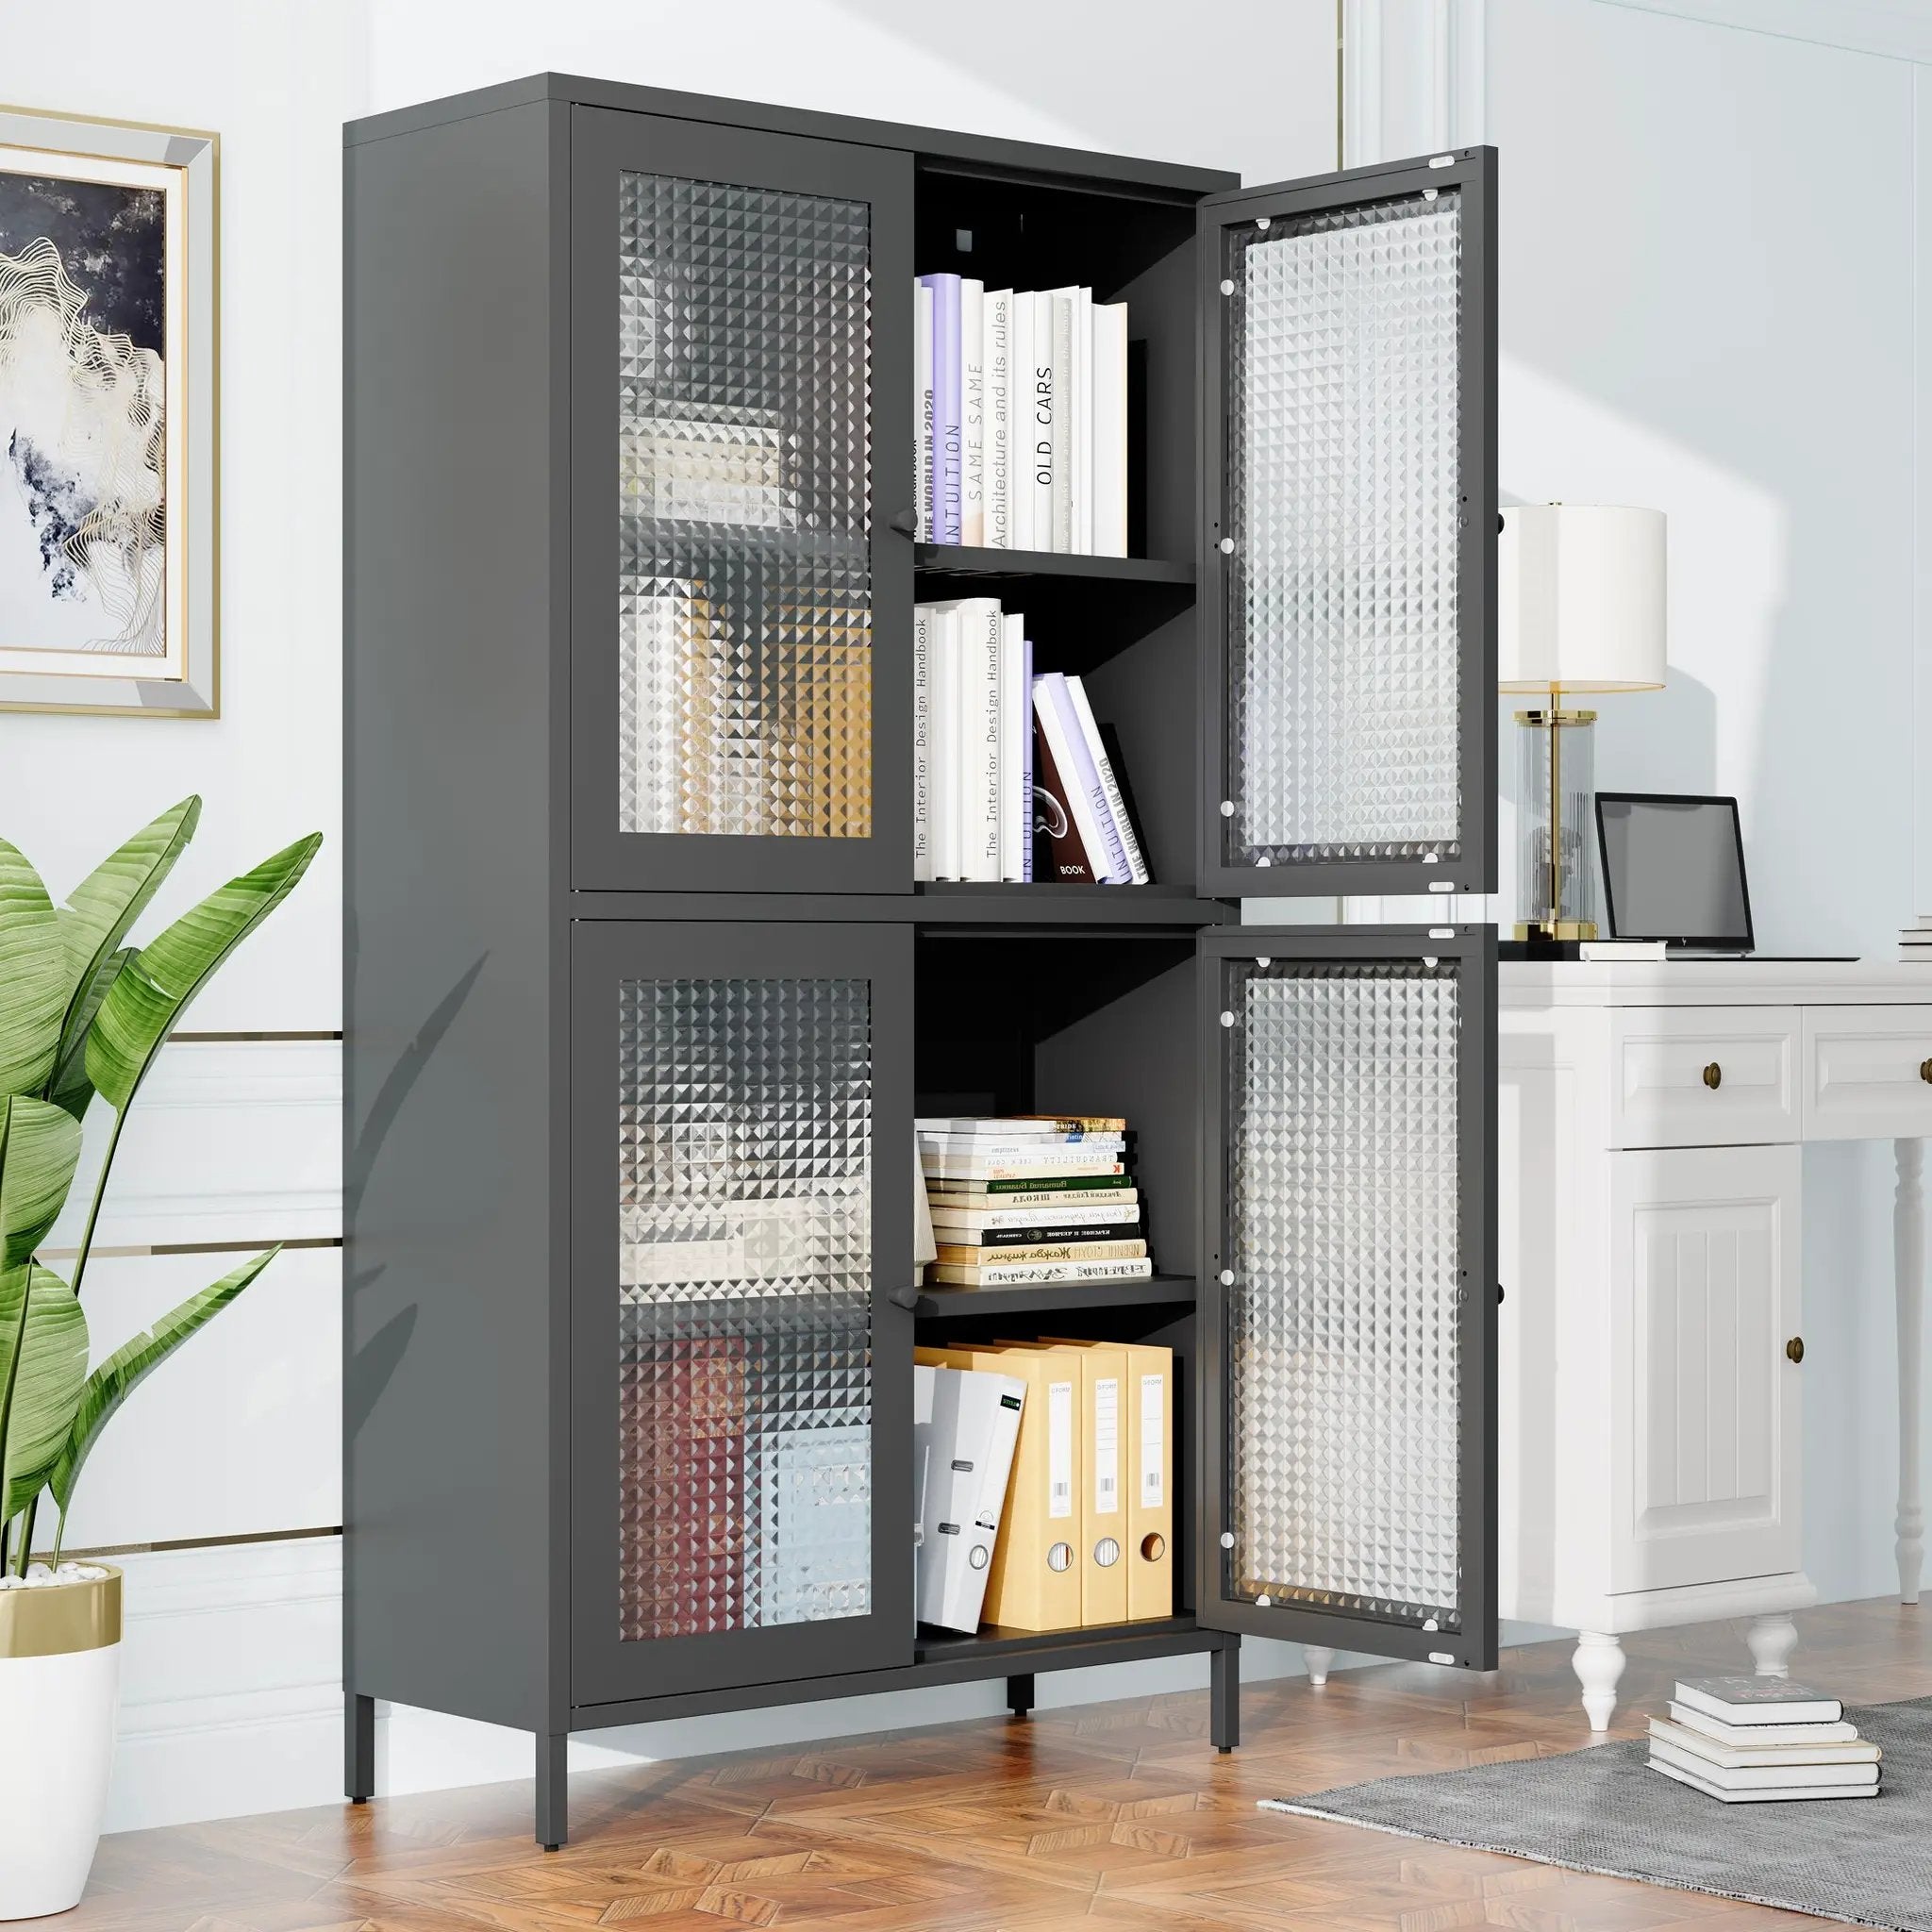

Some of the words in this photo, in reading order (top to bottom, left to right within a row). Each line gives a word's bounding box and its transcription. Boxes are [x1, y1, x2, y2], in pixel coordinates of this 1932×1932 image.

[991, 301, 1006, 349] rules
[991, 357, 1006, 378] its
[924, 390, 934, 430] 2020
[968, 362, 983, 425] SAME
[991, 387, 1006, 422] and
[1036, 366, 1053, 425] CARS
[924, 435, 934, 452] IN
[1036, 441, 1053, 486] OLD
[924, 455, 934, 512] WORLD
[944, 424, 960, 545] INTUITION
[968, 440, 983, 501] SAME
[991, 429, 1007, 548] Architecture
[924, 516, 934, 544] THE
[915, 619, 926, 687] Handbook
[986, 609, 997, 680] Handbook
[916, 695, 929, 746] Design
[986, 690, 999, 742] Design
[916, 757, 926, 824] Interior
[986, 753, 997, 822] Interior
[1099, 757, 1117, 792] 2020
[1110, 792, 1125, 808] IN
[916, 833, 926, 858] The
[986, 832, 997, 858] The
[1091, 786, 1131, 877] INTUITION
[1117, 808, 1138, 854] WORLD
[1059, 865, 1086, 874] BOOK
[1132, 854, 1147, 879] THE
